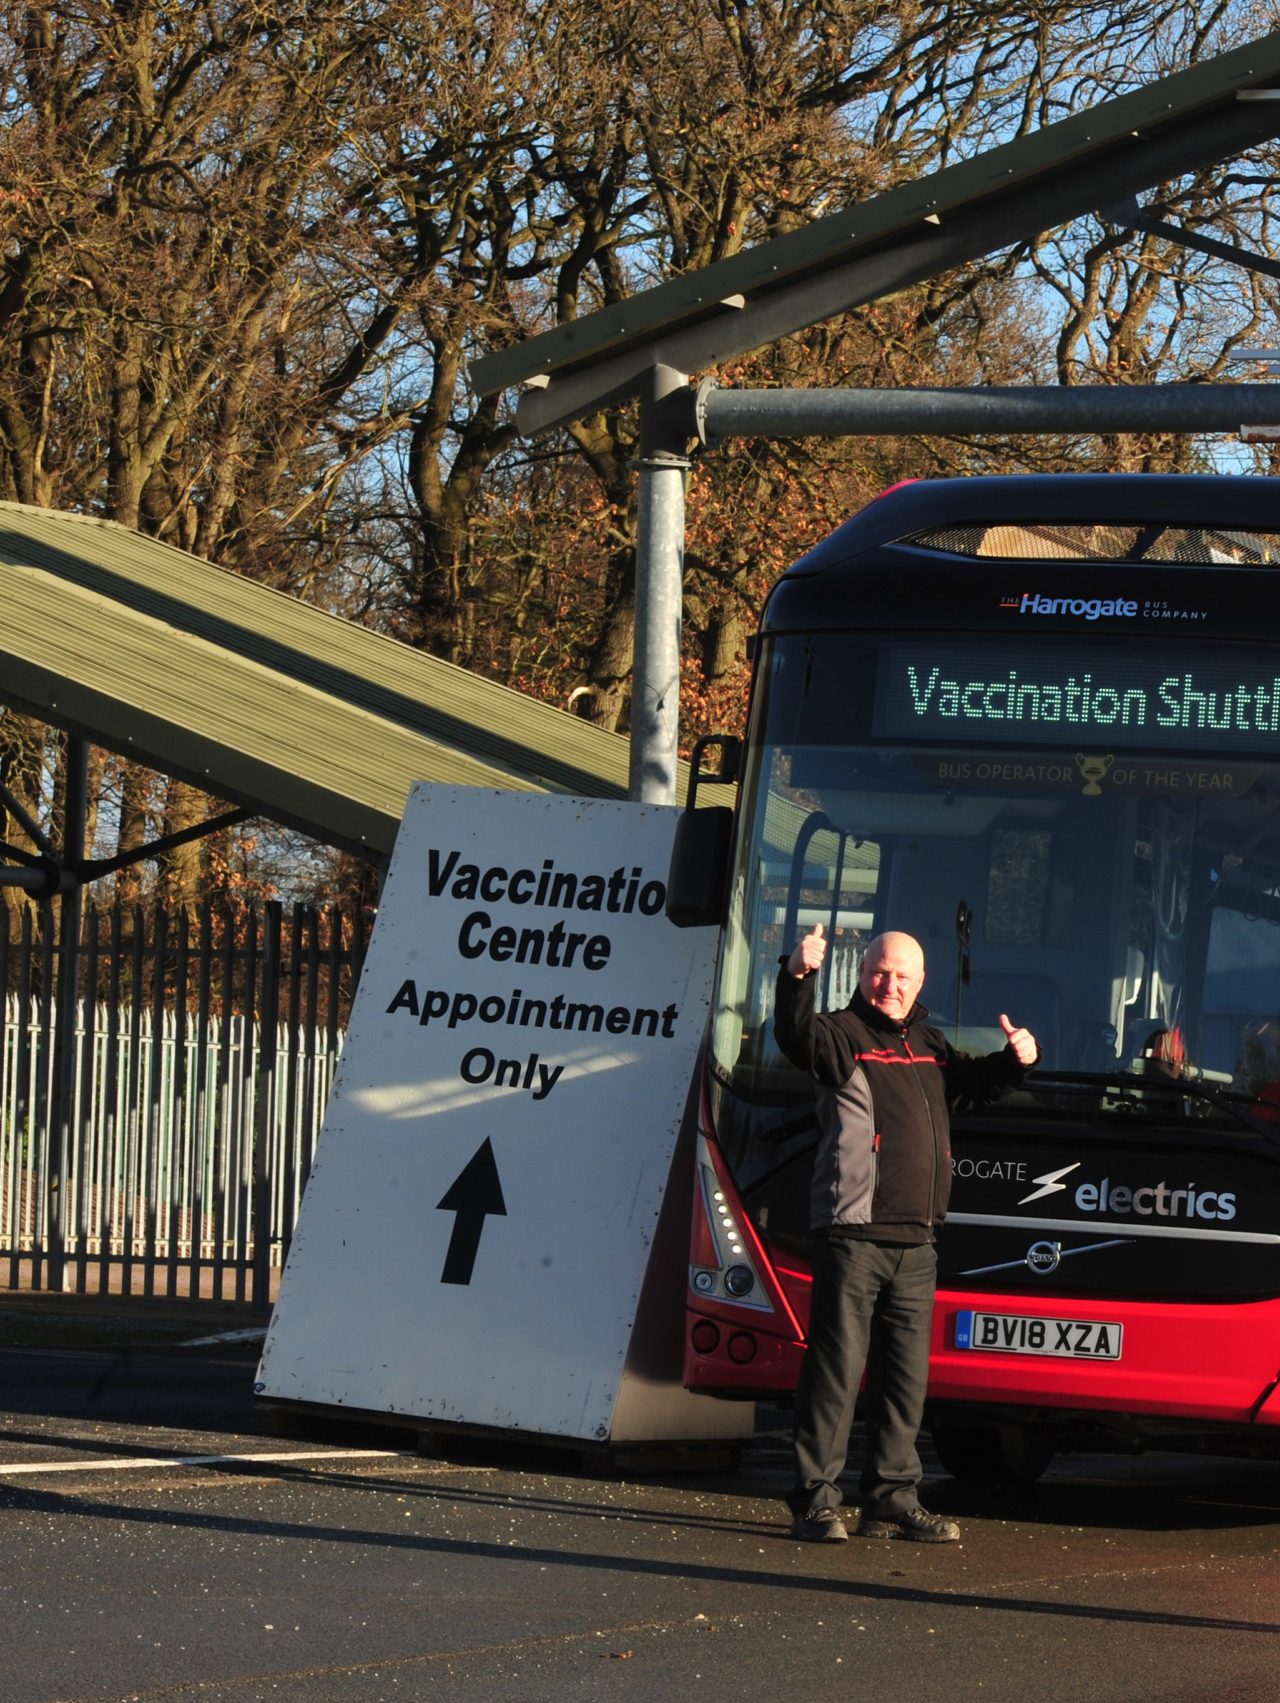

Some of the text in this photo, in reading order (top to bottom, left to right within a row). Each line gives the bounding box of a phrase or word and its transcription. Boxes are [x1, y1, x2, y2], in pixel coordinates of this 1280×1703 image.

[1000, 592, 1139, 620] THE Harrogate
[1143, 609, 1209, 620] COMPANY
[1144, 600, 1169, 609] BUS
[907, 666, 1147, 725] Vaccination
[938, 762, 1234, 789] BUS OPERATOR OF THE YEAR
[428, 849, 667, 916] Vaccinatio
[458, 911, 612, 971] Centre
[386, 979, 679, 1039] Appointment
[460, 1047, 565, 1100] Only
[950, 1157, 1028, 1182] ROGATE
[1075, 1176, 1237, 1221] electrics
[1029, 1254, 1057, 1263] VOLVO
[957, 1332, 969, 1343] GB
[980, 1316, 1111, 1354] BV18 XZA
